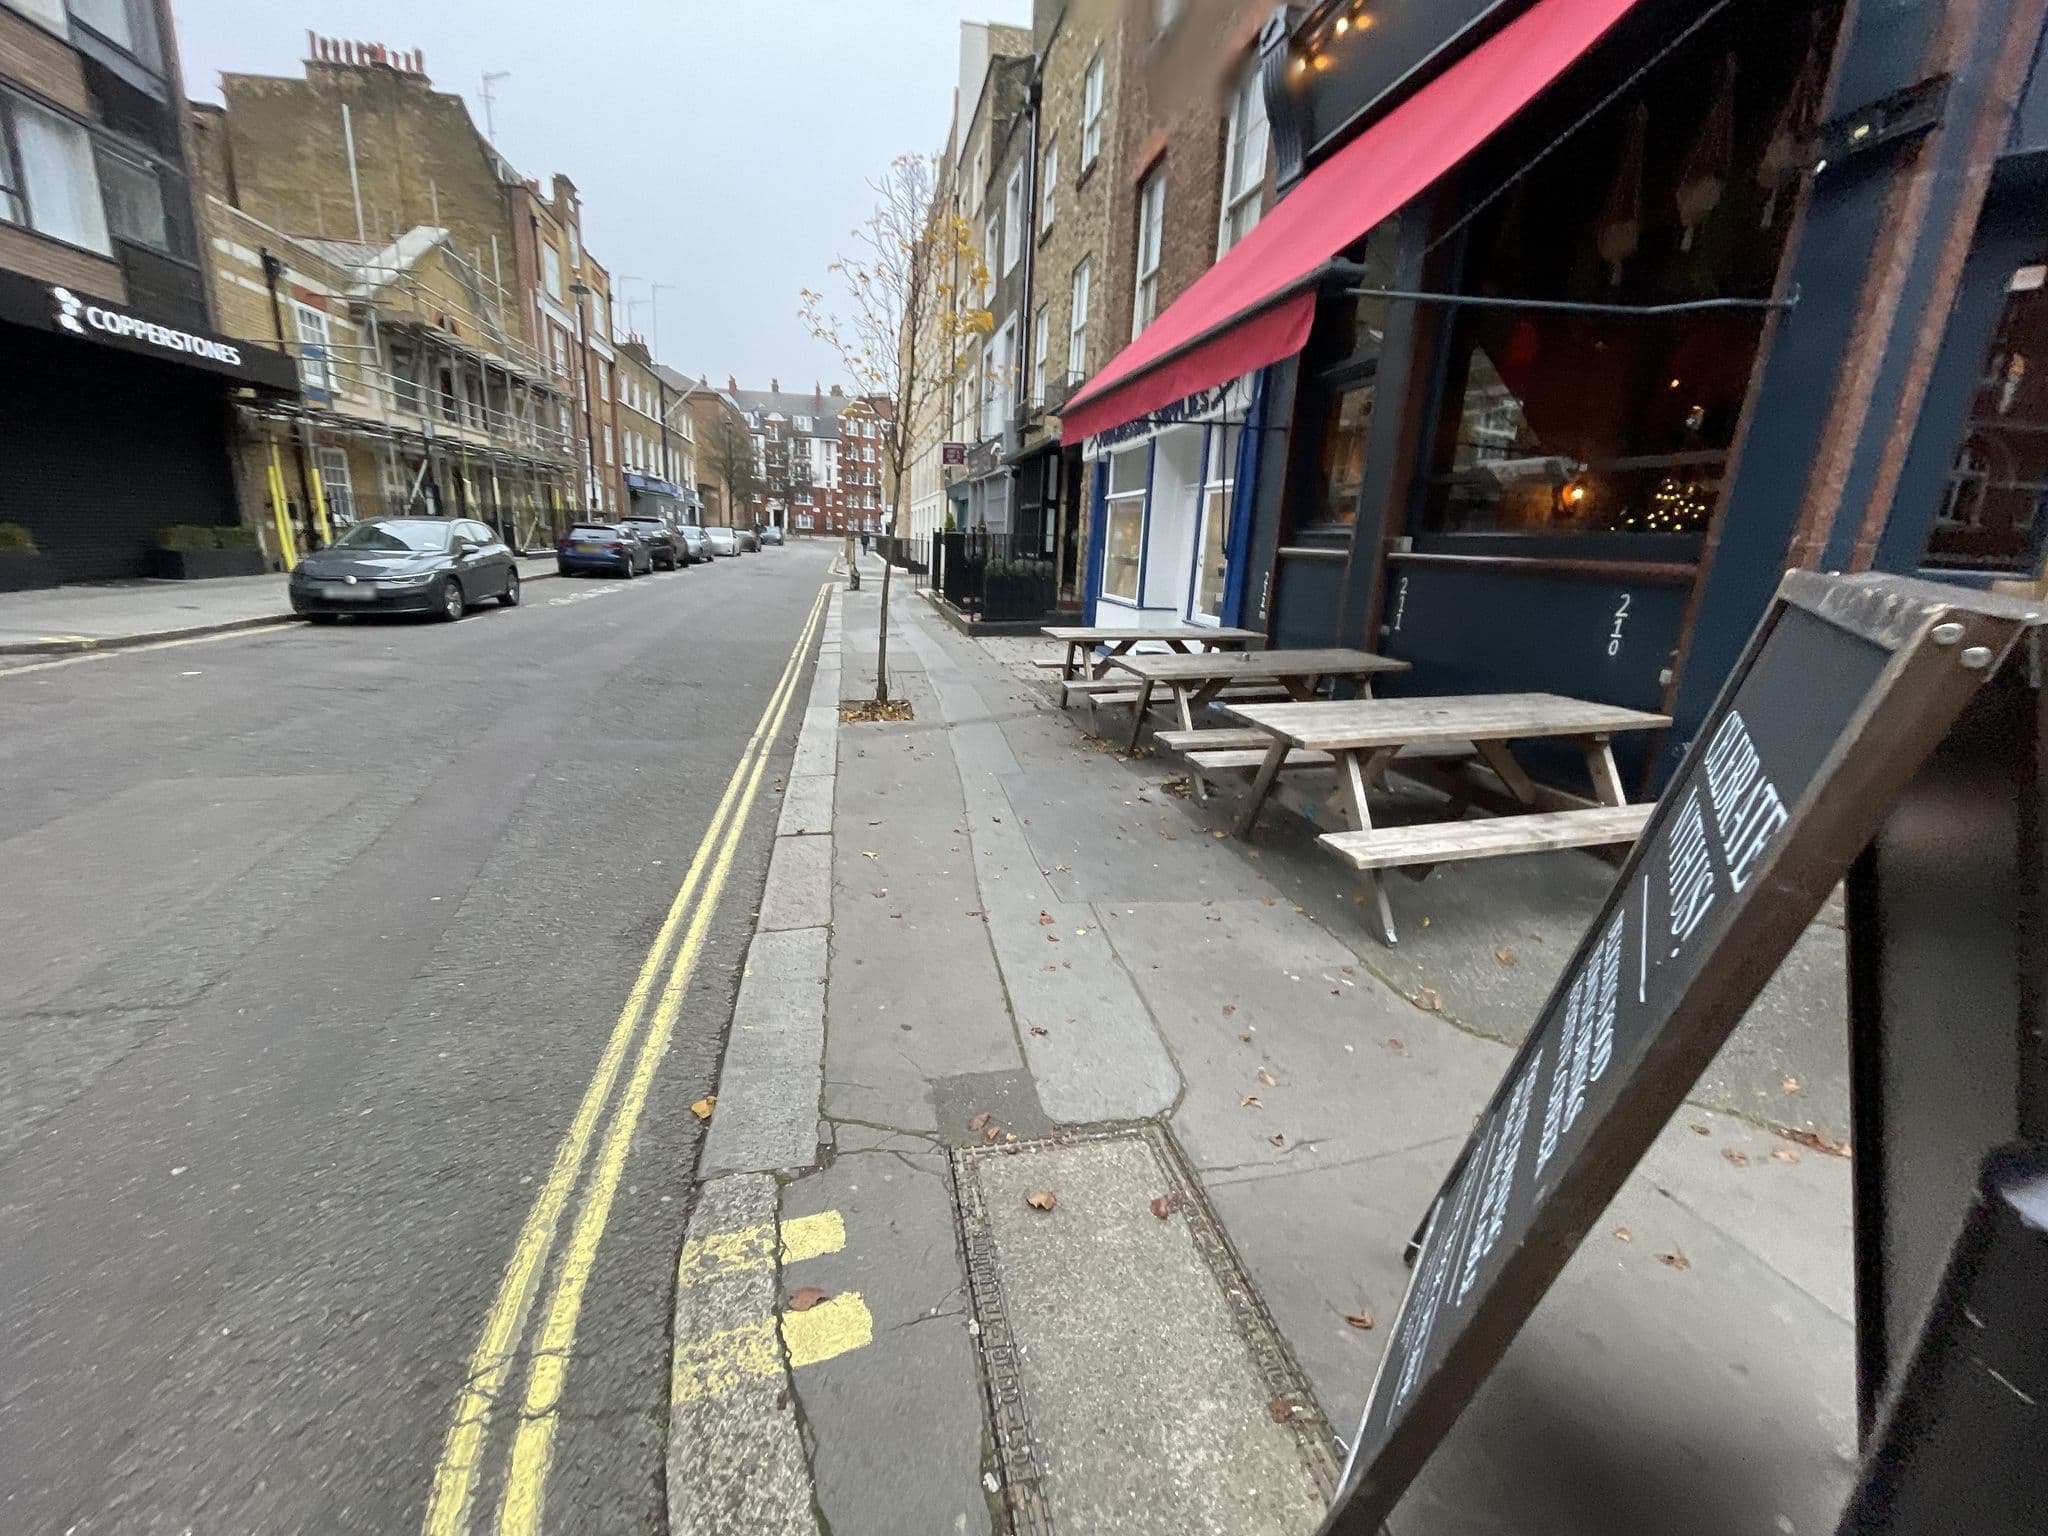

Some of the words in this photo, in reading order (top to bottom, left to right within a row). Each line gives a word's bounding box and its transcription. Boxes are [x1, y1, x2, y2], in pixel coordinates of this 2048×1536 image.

[86, 306, 241, 366] COPPERSTONES
[1394, 577, 1408, 630] 211
[1608, 594, 1631, 656] 210
[1704, 710, 1788, 893] CELEBRATE
[1669, 785, 1709, 896] WITH
